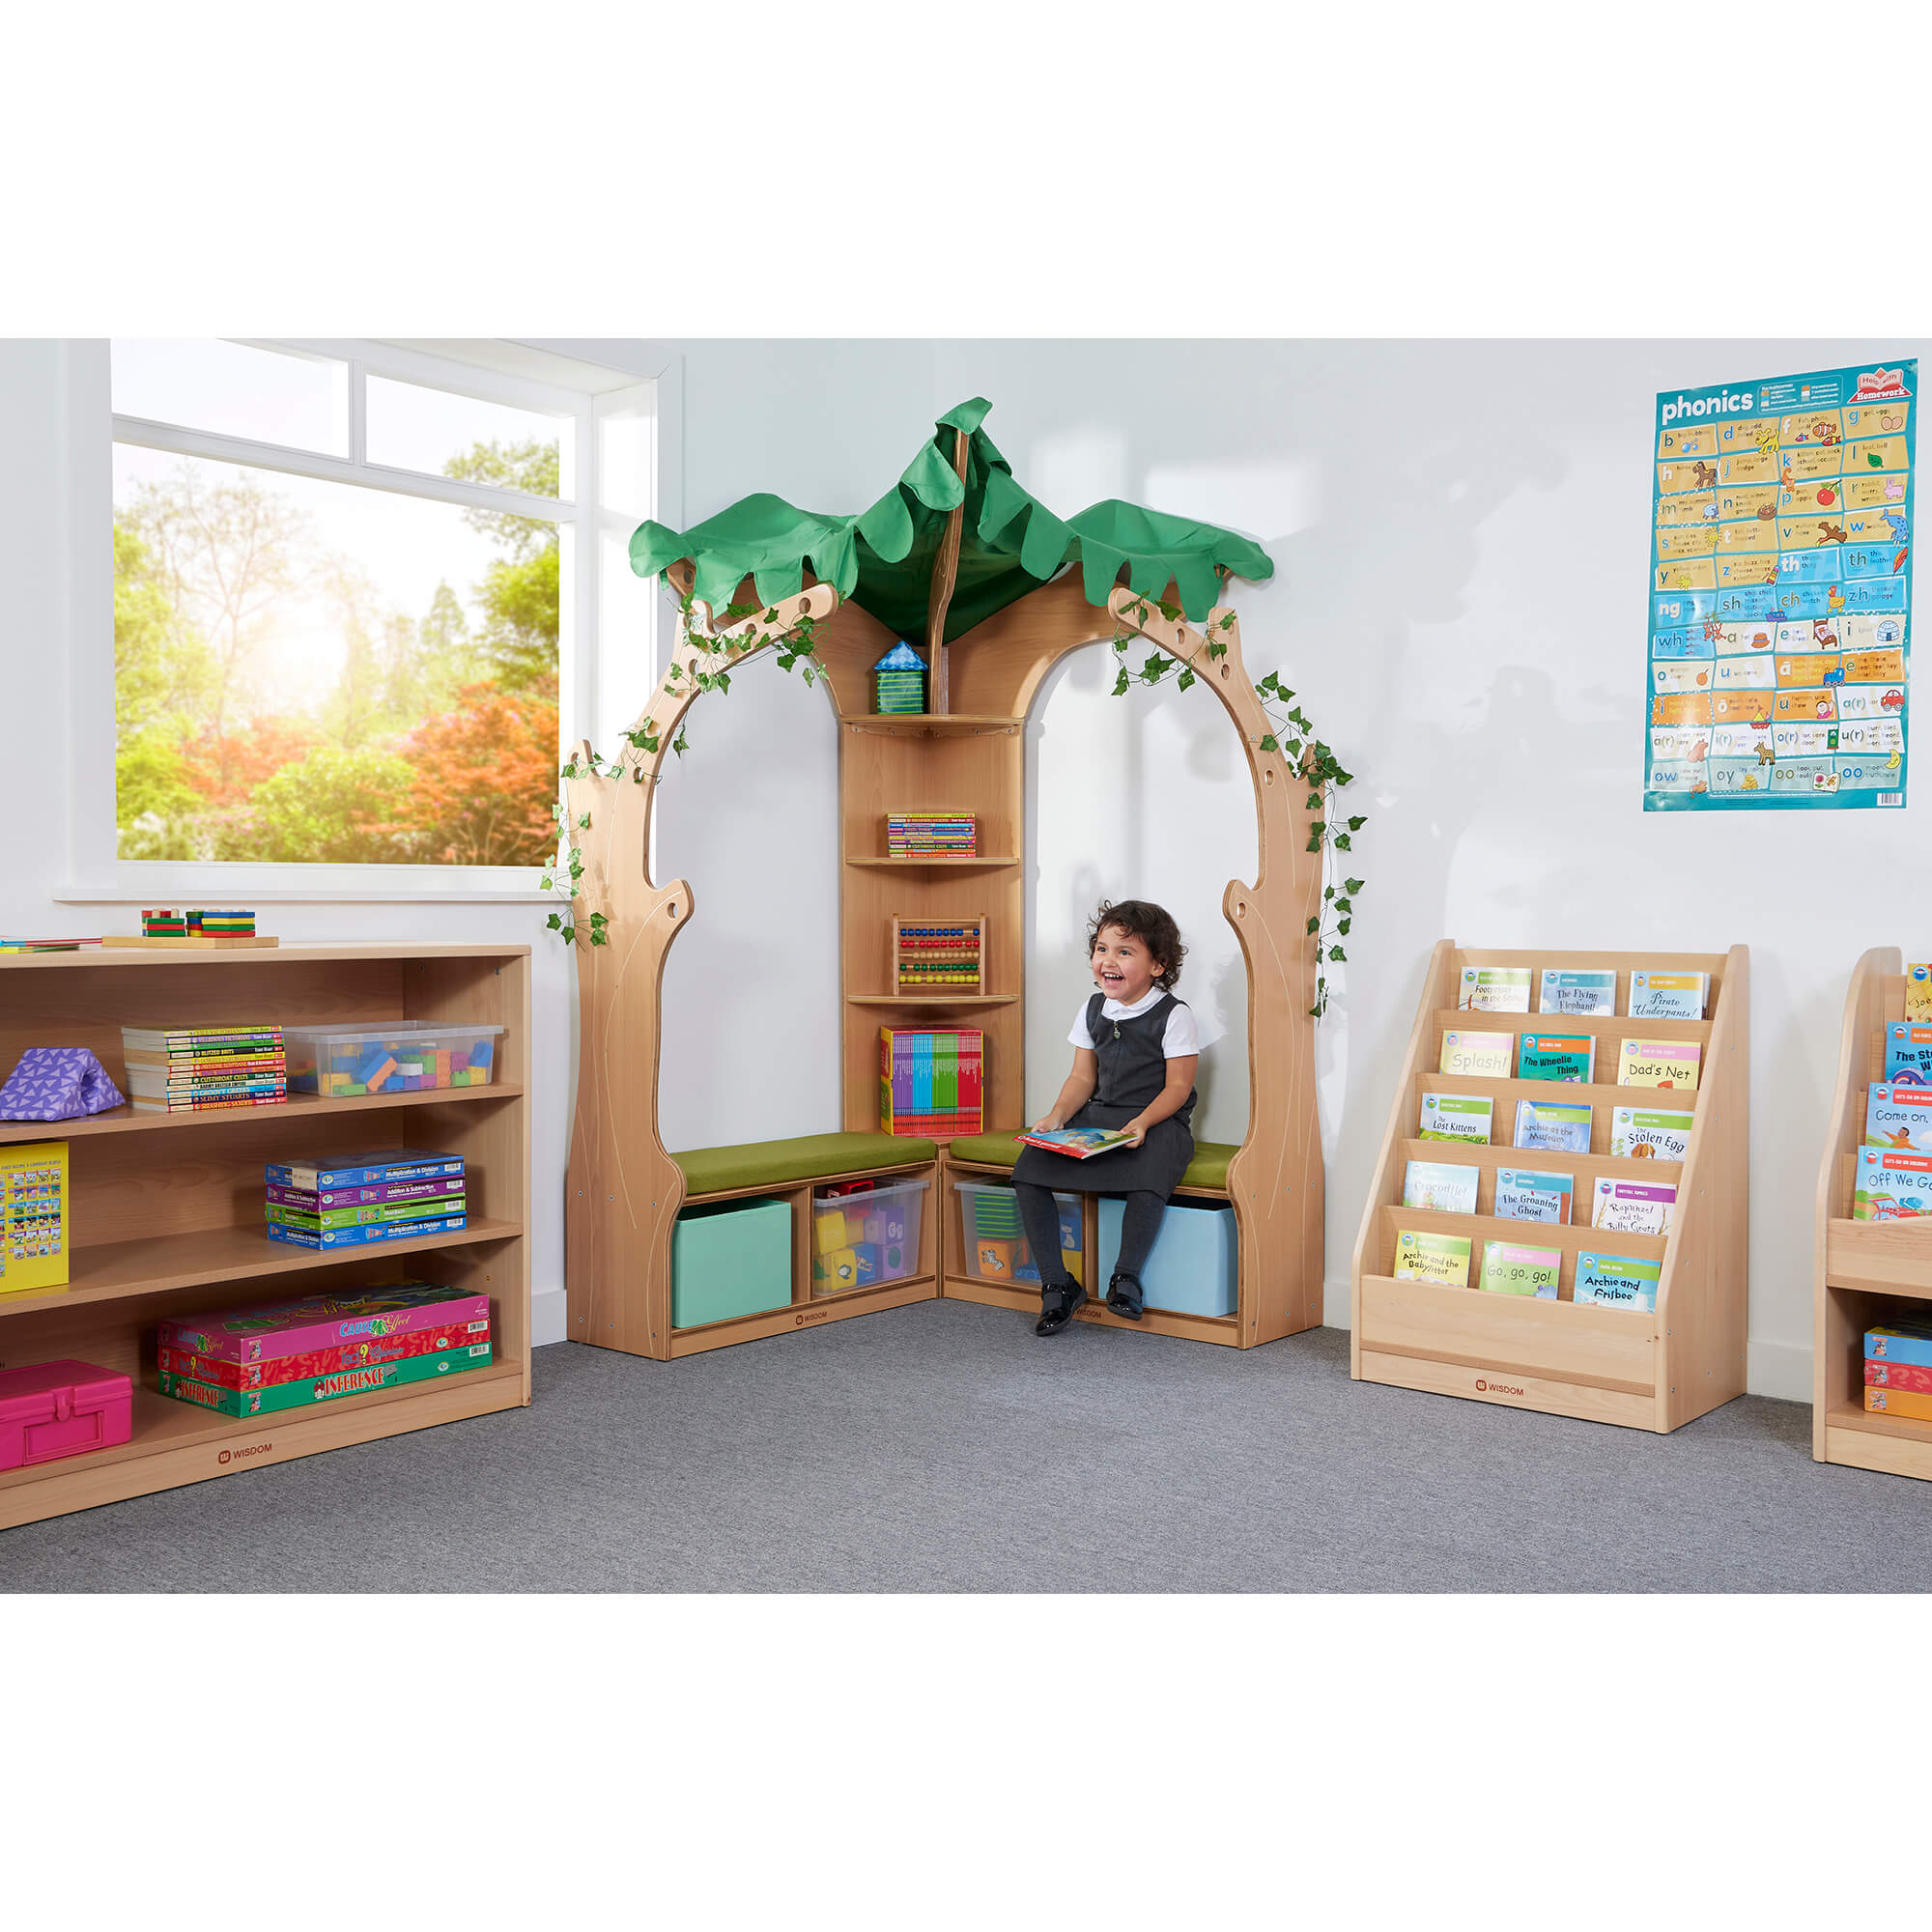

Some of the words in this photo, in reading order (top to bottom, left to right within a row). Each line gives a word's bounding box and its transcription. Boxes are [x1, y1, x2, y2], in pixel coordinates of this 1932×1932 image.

[1857, 387, 1905, 401] Homework
[1662, 389, 1754, 426] phonics
[1848, 410, 1860, 425] g
[1723, 425, 1733, 440] d
[1783, 418, 1791, 434] f
[1664, 433, 1674, 447] b
[1783, 453, 1791, 467] k
[1662, 465, 1673, 481] h
[1723, 459, 1731, 478] j
[1852, 483, 1858, 493] r
[1723, 498, 1733, 509] n
[1782, 494, 1792, 506] p
[1662, 504, 1677, 515] m
[1783, 528, 1792, 538] v
[1850, 522, 1864, 532] w
[1723, 529, 1731, 544] t
[1662, 539, 1669, 549] s
[1781, 555, 1800, 573] th
[1849, 552, 1866, 567] th
[1661, 571, 1669, 584] y
[1722, 566, 1730, 576] z
[1781, 591, 1800, 607] ch
[1849, 587, 1868, 603] zh
[1660, 602, 1680, 618] ng
[1722, 595, 1741, 611] sh
[1780, 630, 1789, 639] e
[1847, 621, 1851, 636] i
[1659, 632, 1682, 647] wh
[1727, 633, 1737, 642] a
[1658, 671, 1666, 681] o
[1720, 668, 1730, 678] u
[1843, 697, 1865, 711] a(r)
[1777, 731, 1798, 744] o(r)
[1842, 729, 1863, 742] u(r)
[1655, 772, 1677, 781] ow
[1717, 770, 1734, 784] oy
[1776, 770, 1795, 780] oo
[1843, 768, 1862, 779] oo
[1557, 989, 1572, 999] The
[1574, 988, 1599, 1002] Flying
[1650, 991, 1681, 1006] Pirate
[1559, 1001, 1595, 1011] Elephant!
[1634, 1003, 1698, 1019] Underpants!
[1452, 1052, 1507, 1071] Splash!
[1524, 1056, 1538, 1066] The
[1540, 1055, 1572, 1066] Wheelie
[1895, 1051, 1915, 1062] The
[1556, 1065, 1578, 1075] Thing
[1629, 1064, 1662, 1075] Dad's
[1665, 1065, 1690, 1080] Net
[1876, 1110, 1907, 1122] Come
[1911, 1113, 1928, 1123] on,
[1433, 1120, 1449, 1130] Lost
[1450, 1122, 1477, 1133] Kittens
[1560, 1126, 1574, 1136] the
[1529, 1133, 1564, 1143] Museum
[1628, 1131, 1662, 1145] Stolen
[1664, 1136, 1685, 1153] Egg
[1868, 1172, 1890, 1187] Off
[1895, 1174, 1913, 1187] We
[1502, 1194, 1518, 1204] The
[1520, 1194, 1558, 1212] Groaning
[1518, 1203, 1543, 1216] Ghost
[1403, 1250, 1428, 1261] Archie
[1430, 1255, 1445, 1265] and
[1445, 1259, 1459, 1268] the
[1510, 1268, 1529, 1281] go,
[1532, 1270, 1551, 1284] go!
[1584, 1275, 1619, 1288] Archie
[1620, 1280, 1640, 1292] and
[1594, 1288, 1633, 1301] Frisbee
[804, 1311, 828, 1322] WISDOM
[1076, 1308, 1102, 1319] WISDOM
[340, 1321, 373, 1337] CAUSE
[325, 1367, 384, 1396] INFERENCE
[181, 1379, 219, 1407] INFERENCE
[1489, 1382, 1524, 1397] WISDOM
[233, 1443, 272, 1459] WISDOM
